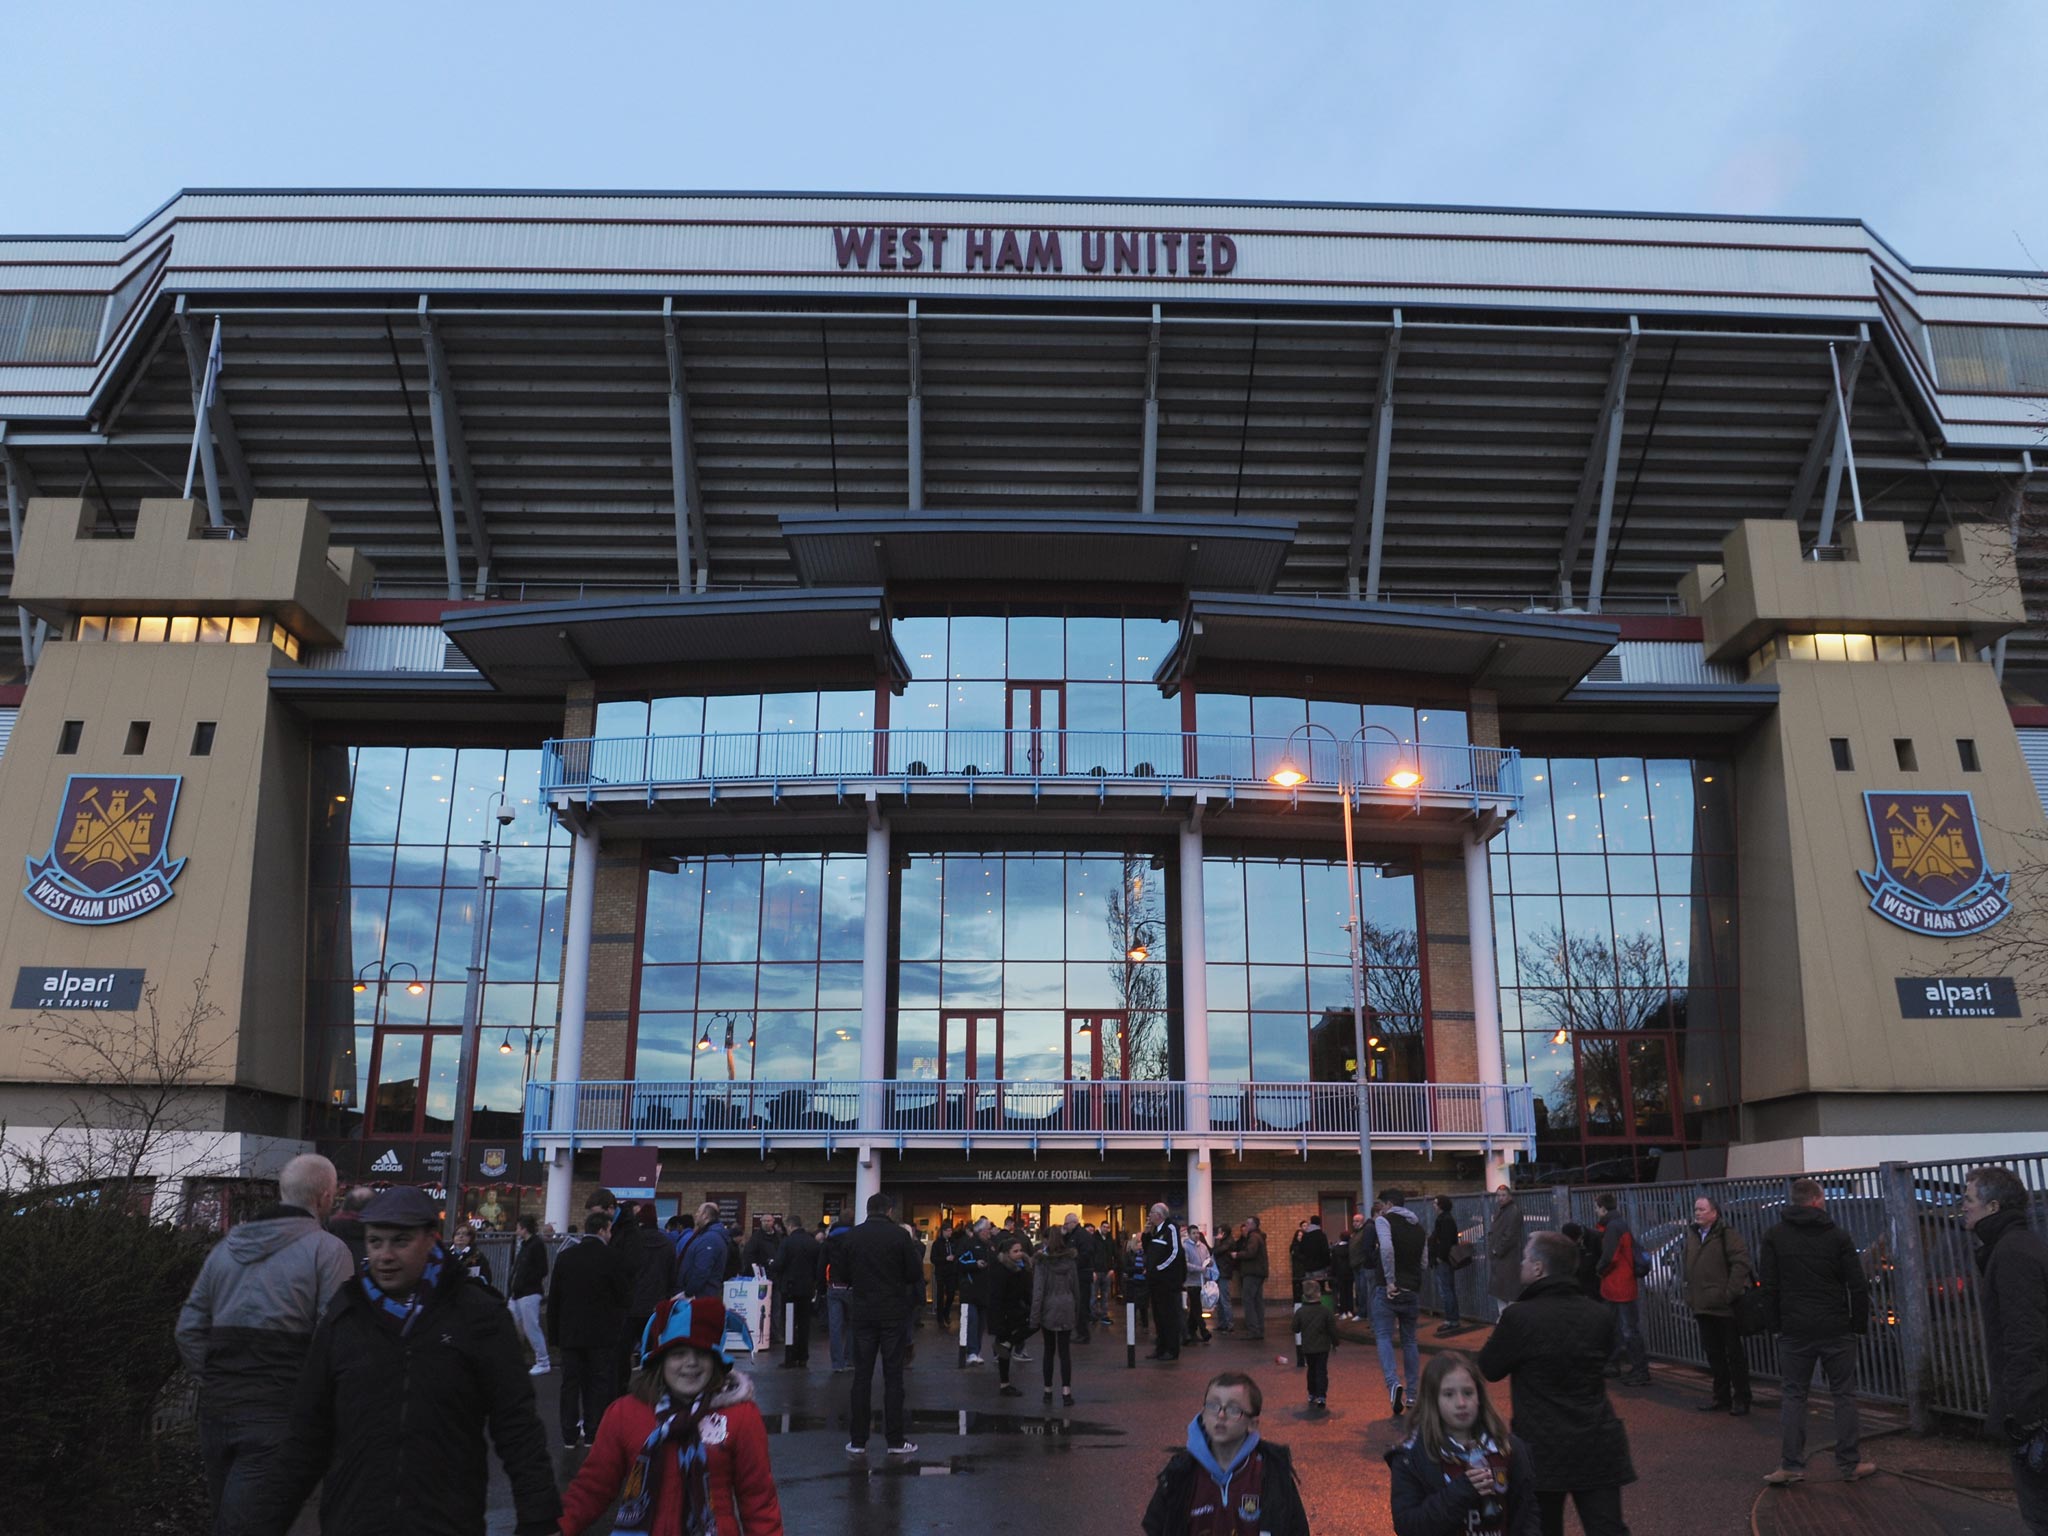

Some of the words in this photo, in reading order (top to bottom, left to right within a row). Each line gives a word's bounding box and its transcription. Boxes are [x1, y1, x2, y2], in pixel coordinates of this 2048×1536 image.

[833, 227, 948, 269] WEST
[966, 229, 1063, 272] HAM
[1081, 231, 1238, 274] UNITED
[34, 880, 72, 911] WEST
[69, 898, 104, 917] HAM
[108, 882, 161, 916] UNITED
[1882, 894, 1921, 924] WEST
[1923, 911, 1957, 929] HAM
[1956, 895, 2002, 928] UNITED
[43, 969, 115, 999] alpari
[1925, 979, 1992, 1008] alpari
[39, 999, 54, 1007] FX
[59, 999, 110, 1007] TRADING
[1929, 1007, 1943, 1016] FX
[1947, 1007, 1996, 1016] TRADING
[370, 1162, 403, 1172] adidas
[977, 1170, 993, 1180] THE
[995, 1170, 1036, 1180] ACADEMY
[1037, 1170, 1049, 1180] OF
[1051, 1170, 1093, 1180] FOOTBALL
